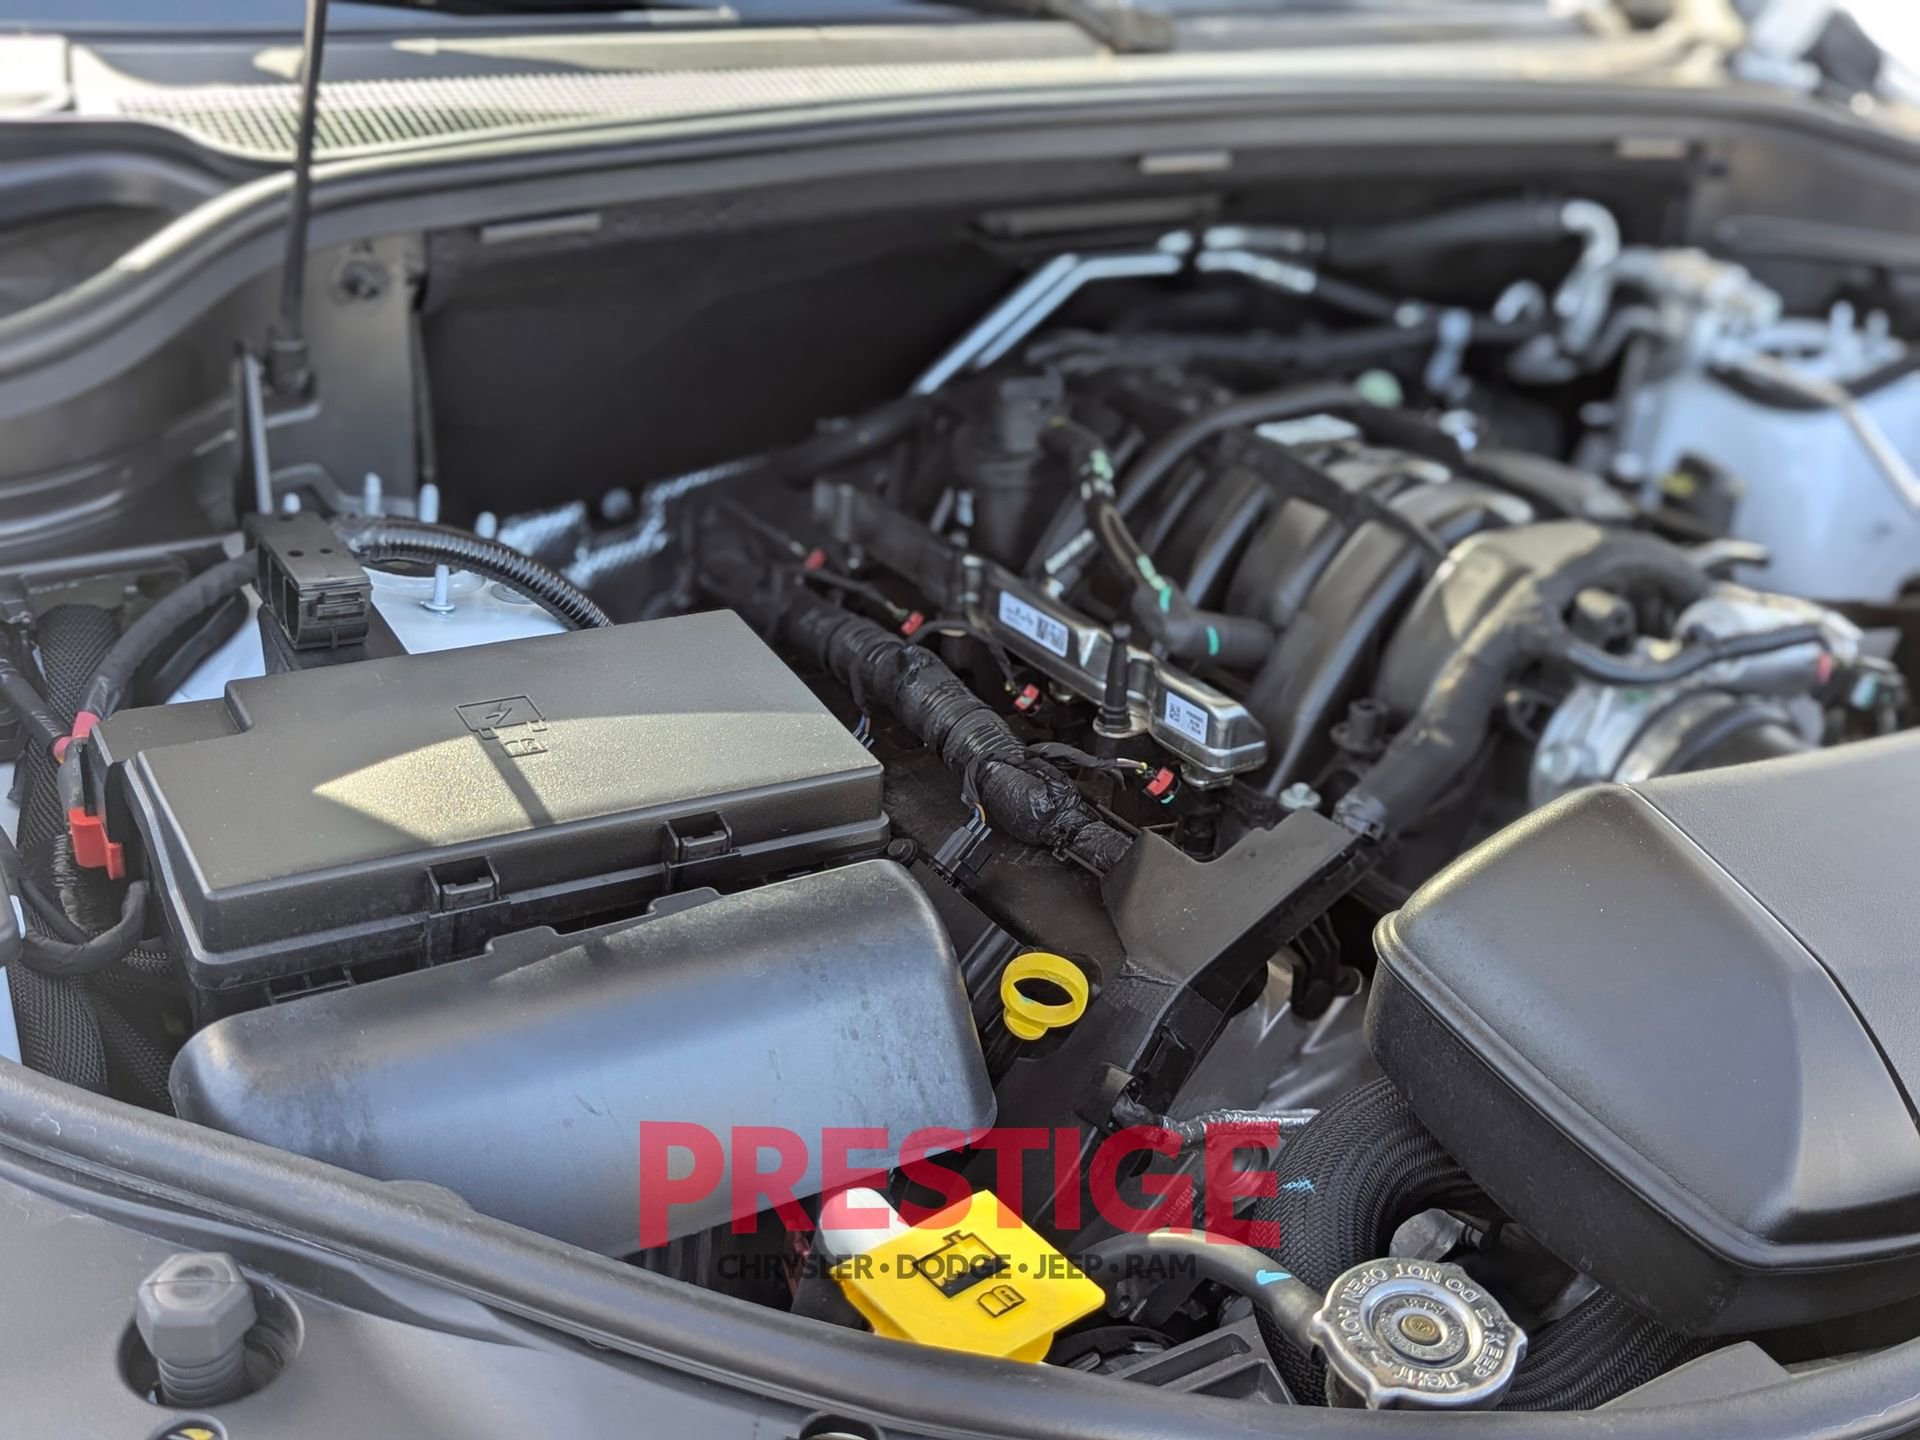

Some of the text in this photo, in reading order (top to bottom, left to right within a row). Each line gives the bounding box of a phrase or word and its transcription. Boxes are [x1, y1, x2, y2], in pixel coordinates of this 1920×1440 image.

[1341, 1266, 1389, 1303] OPEN
[1394, 1263, 1442, 1284] NOT
[1445, 1278, 1480, 1302] DO
[1473, 1330, 1506, 1377] KEEP
[1393, 1365, 1470, 1389] TIGHT
